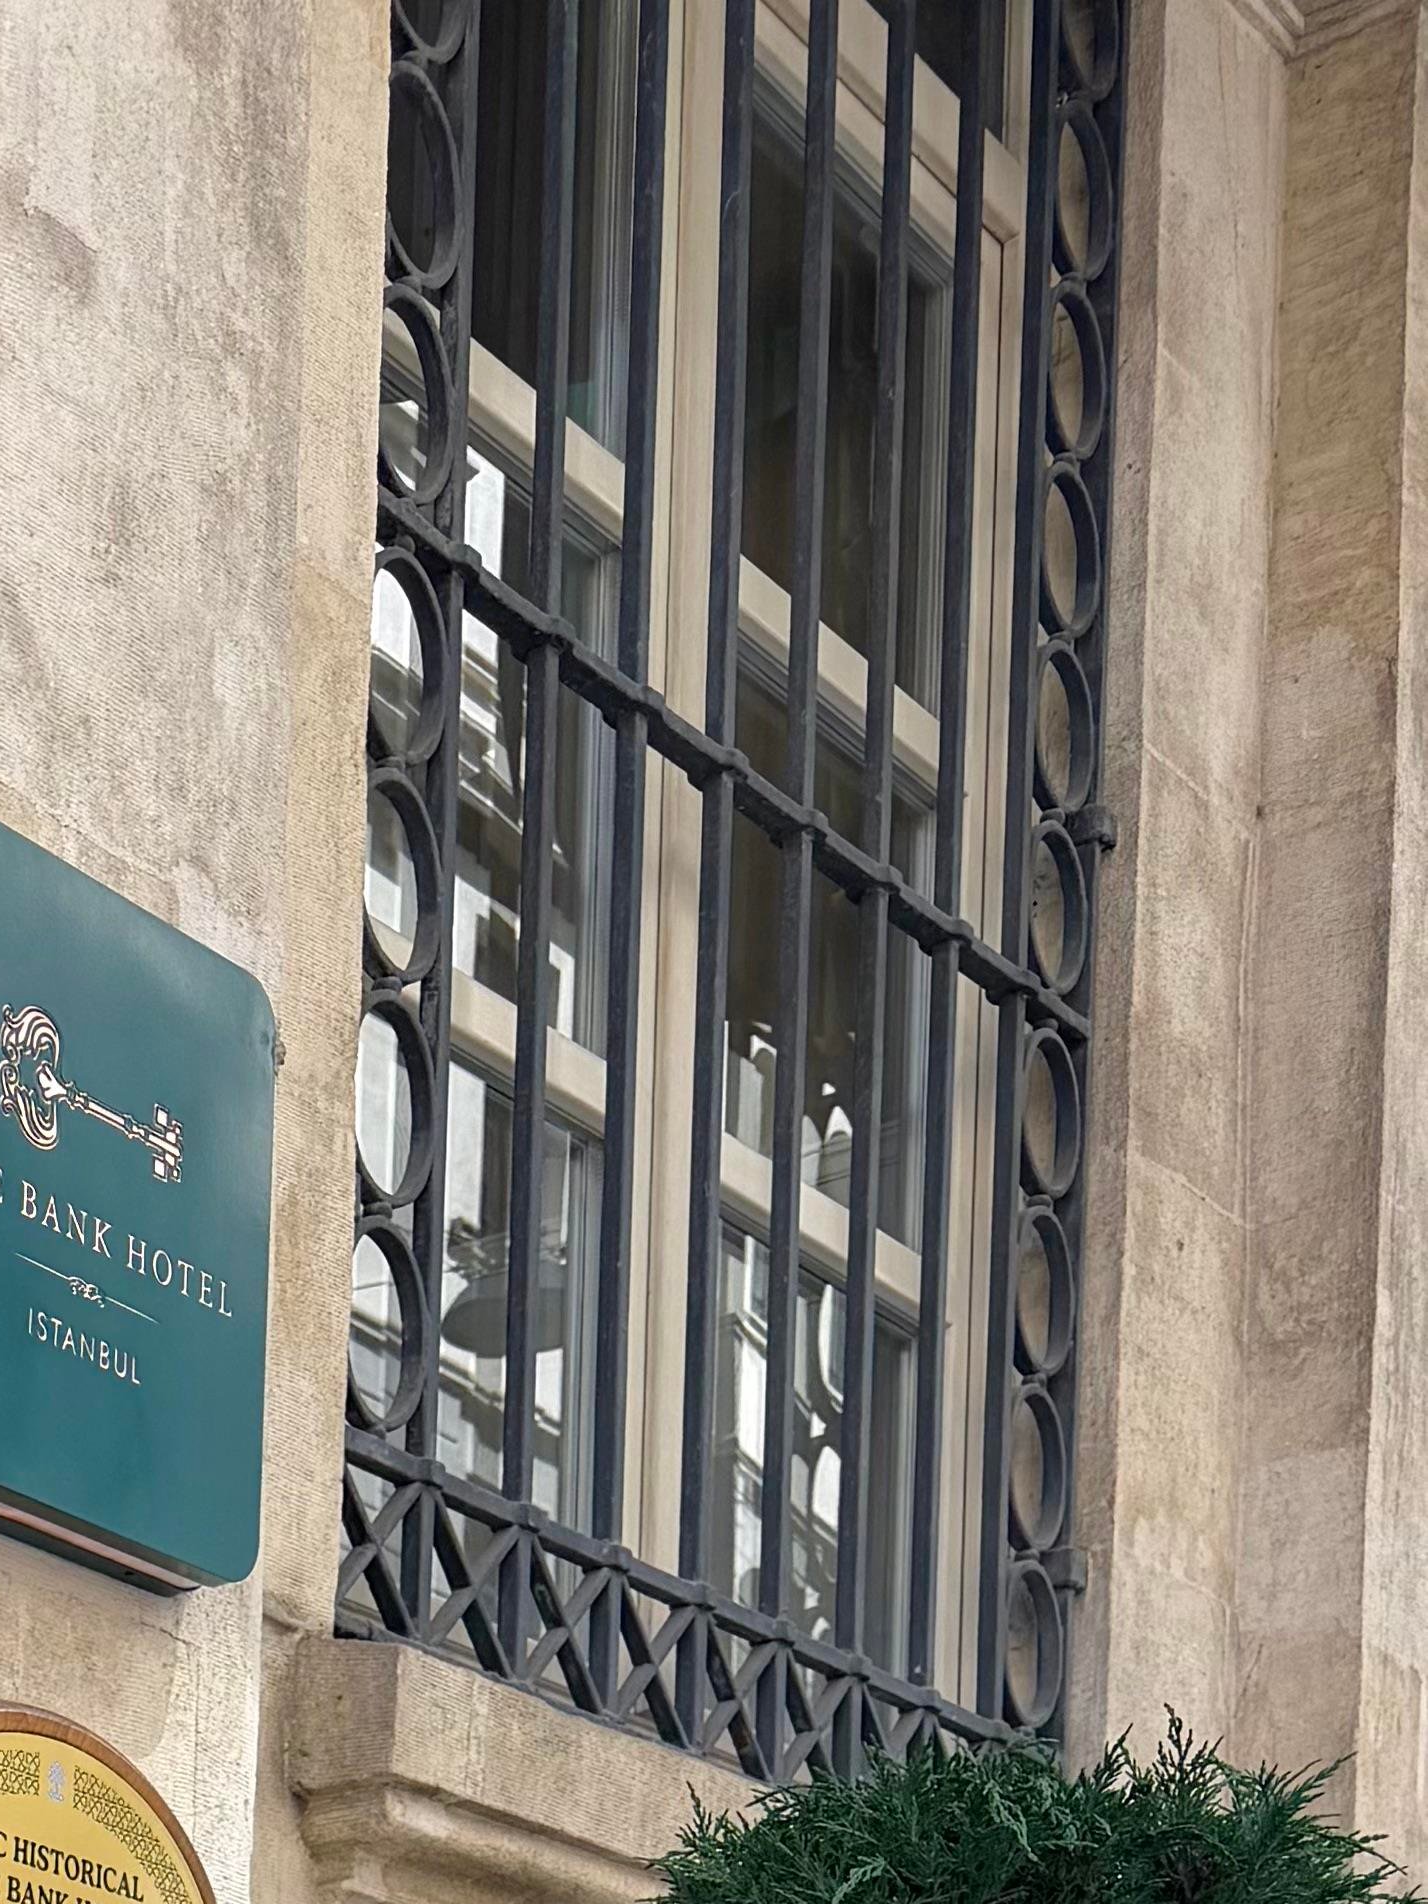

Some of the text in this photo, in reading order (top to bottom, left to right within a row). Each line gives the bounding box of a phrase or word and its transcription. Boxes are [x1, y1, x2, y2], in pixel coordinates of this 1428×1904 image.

[21, 1180, 112, 1258] BANK
[126, 1234, 232, 1317] HOTEL
[28, 1307, 140, 1384] ISTANBUL
[13, 1836, 144, 1902] HISTORICAL
